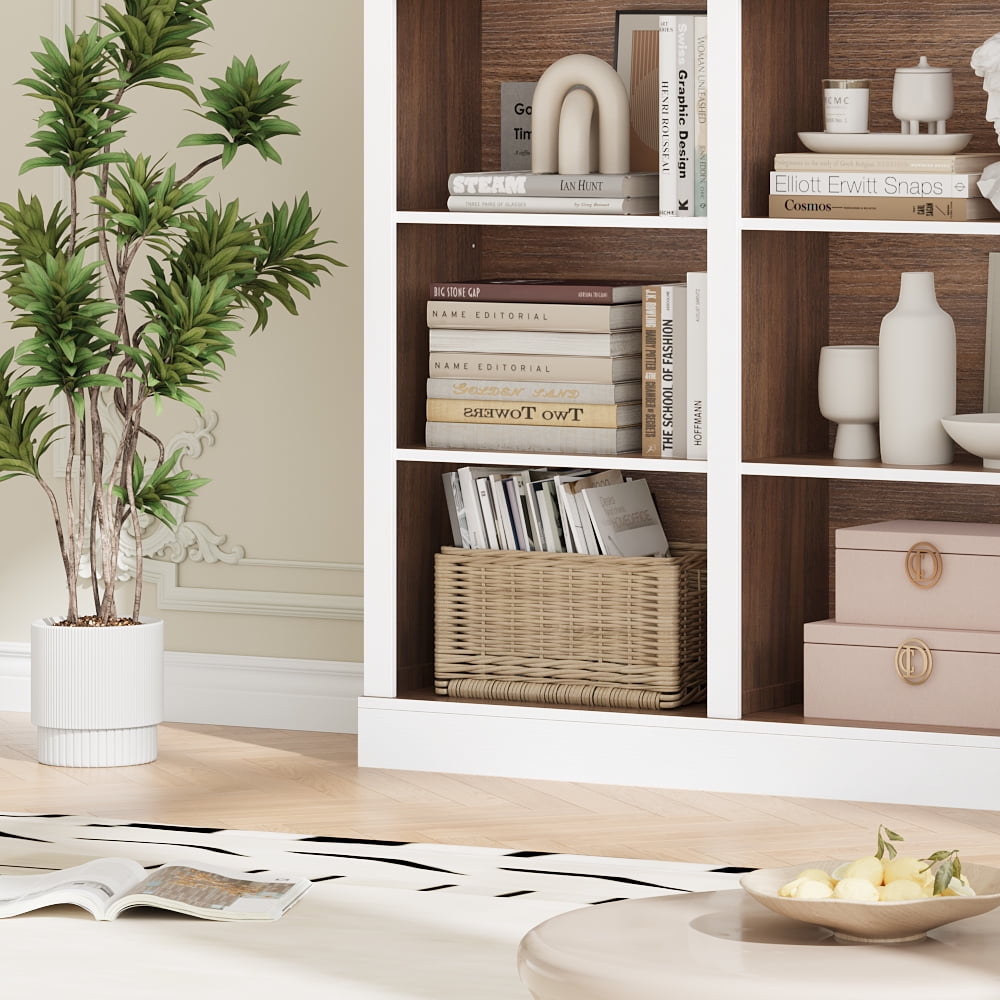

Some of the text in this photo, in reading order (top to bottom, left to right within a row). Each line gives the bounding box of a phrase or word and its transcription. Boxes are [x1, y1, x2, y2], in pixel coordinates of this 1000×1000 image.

[697, 36, 706, 124] WOMAN UNLEASHED
[677, 70, 688, 125] Graphic
[662, 117, 670, 173] ROUSSEAU
[679, 130, 688, 179] Design
[452, 176, 527, 195] STEAM
[560, 180, 604, 192] IAN HUNT
[775, 175, 943, 197] Elliott Erwitt Snaps
[784, 199, 832, 212] Cosmos
[434, 287, 480, 298] BIG STONE GAP
[432, 310, 548, 321] NAME EDITORIAL
[646, 329, 657, 348] HARRY
[662, 319, 673, 365] FASHION
[434, 362, 550, 372] NAME EDITORIAL
[646, 349, 656, 370] POTTER
[662, 368, 673, 381] OF
[646, 382, 656, 408] CHAMBER
[662, 385, 673, 428] SCHOOL
[646, 414, 656, 438] SECRETS
[694, 400, 702, 446] HOFFMANN
[662, 430, 673, 451] THE
